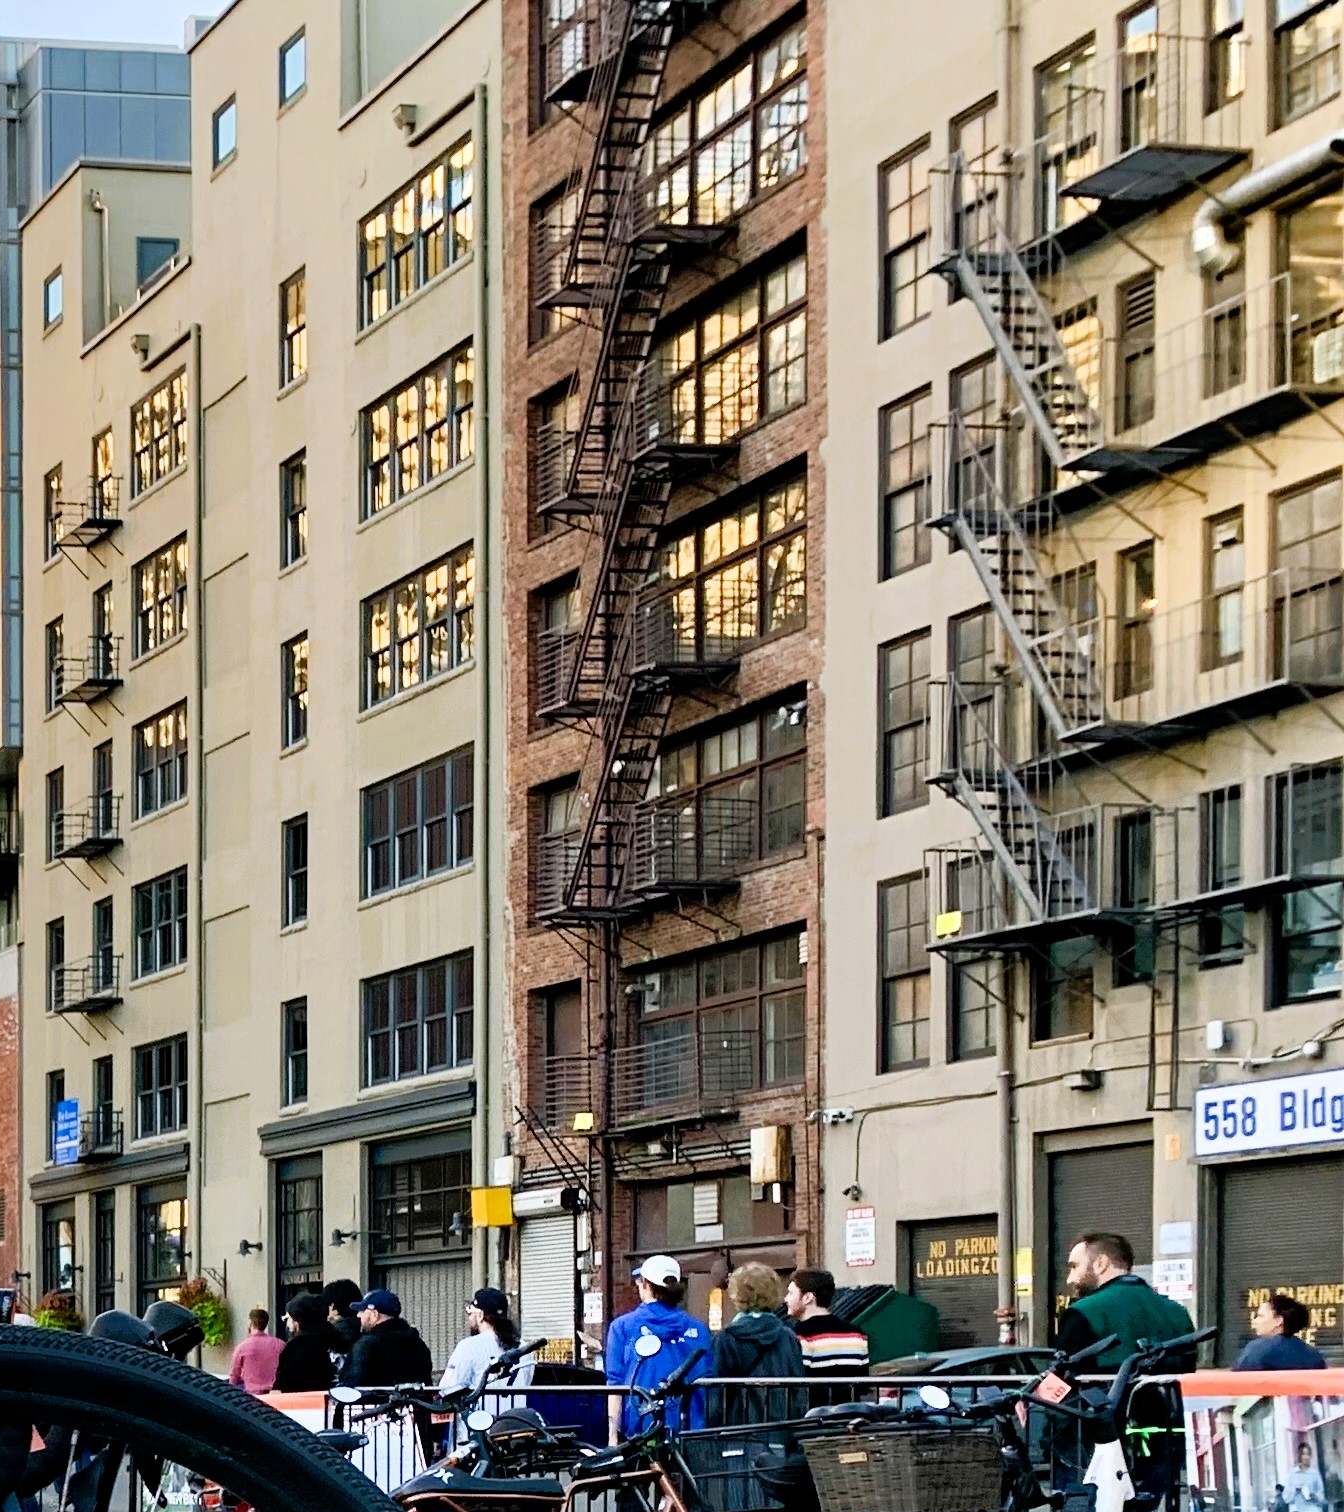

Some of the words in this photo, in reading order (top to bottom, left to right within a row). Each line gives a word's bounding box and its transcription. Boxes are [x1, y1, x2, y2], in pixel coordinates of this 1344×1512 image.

[1204, 1096, 1257, 1140] 558
[1279, 1086, 1344, 1133] Bldg
[929, 1240, 947, 1259] NO
[955, 1235, 998, 1256] PARKIN
